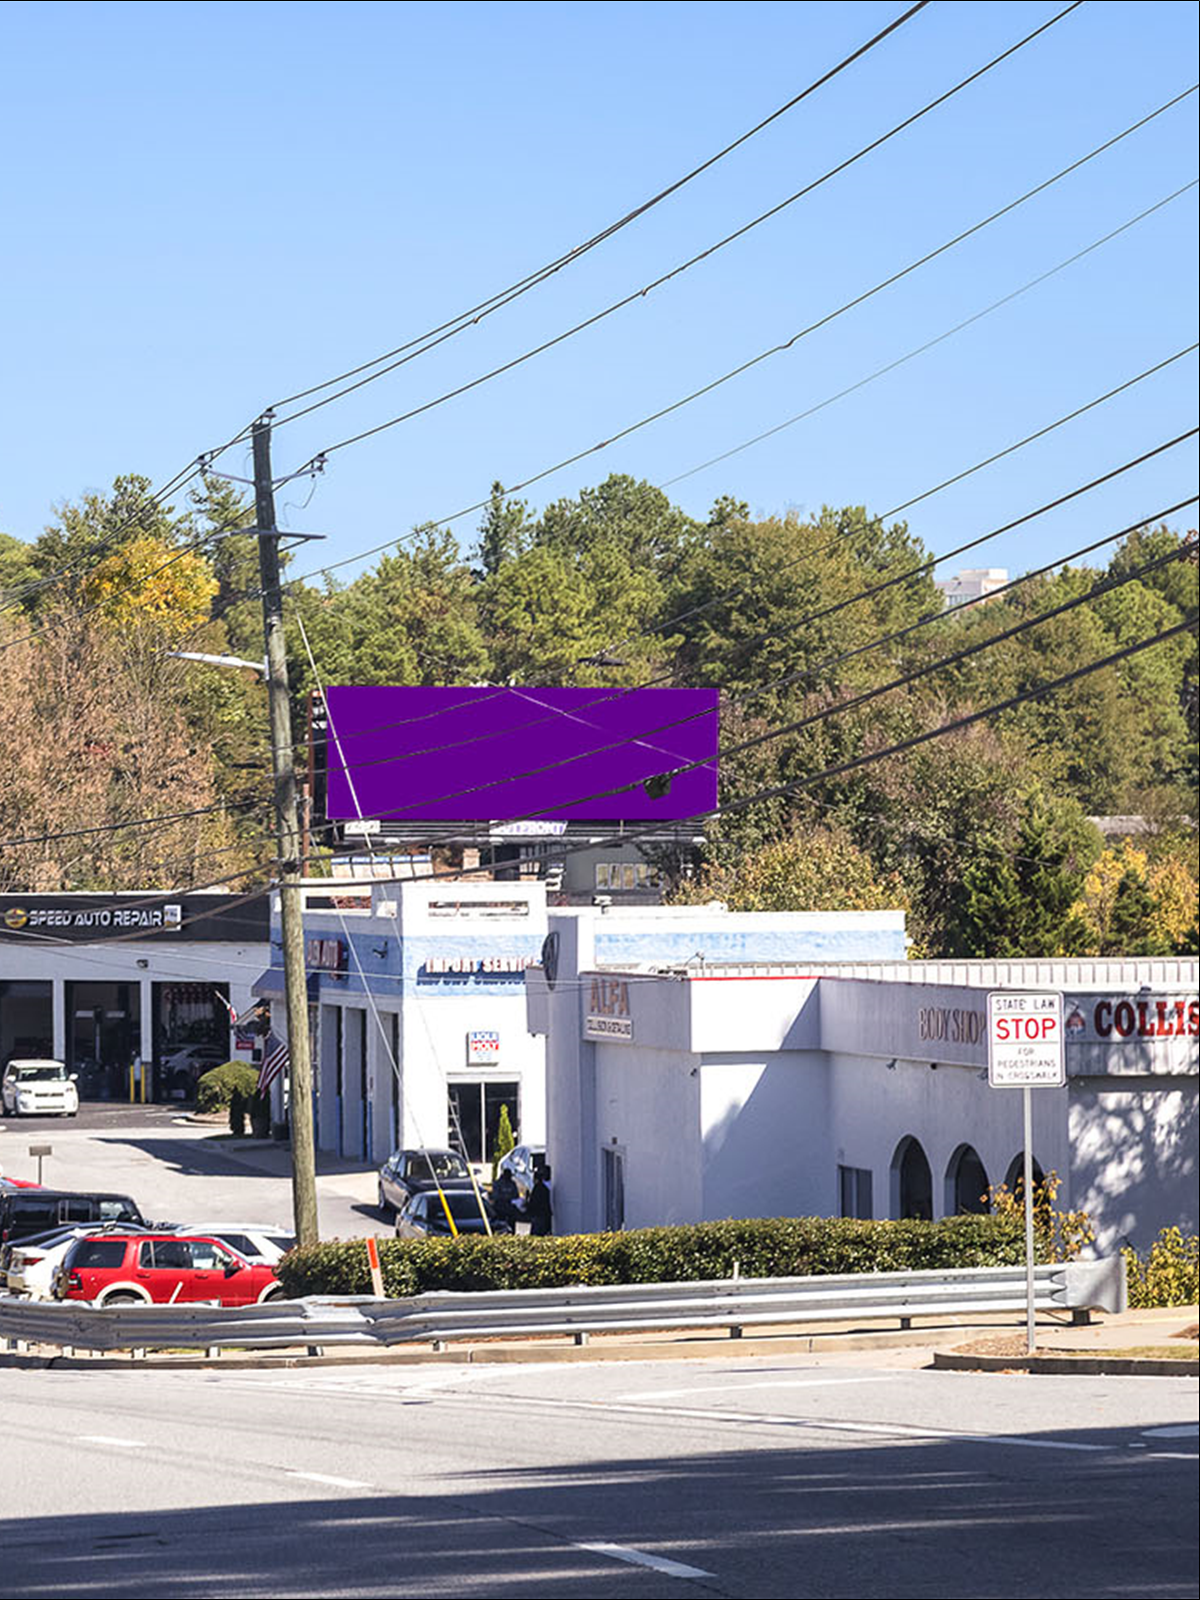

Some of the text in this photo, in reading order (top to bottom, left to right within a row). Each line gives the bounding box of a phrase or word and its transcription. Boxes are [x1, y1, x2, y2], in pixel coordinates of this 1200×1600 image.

[28, 910, 72, 926] SPEED
[74, 910, 112, 926] AUTO
[113, 910, 162, 926] REPAIR
[425, 957, 479, 973] IMPORT
[590, 978, 631, 1016] ALFA
[995, 998, 1056, 1011] STATE LAW
[919, 1006, 988, 1045] BODY SHOP
[1093, 1000, 1198, 1037] COLLIS
[996, 1017, 1057, 1040] STOP
[997, 1058, 1056, 1069] PEDESTRIANS
